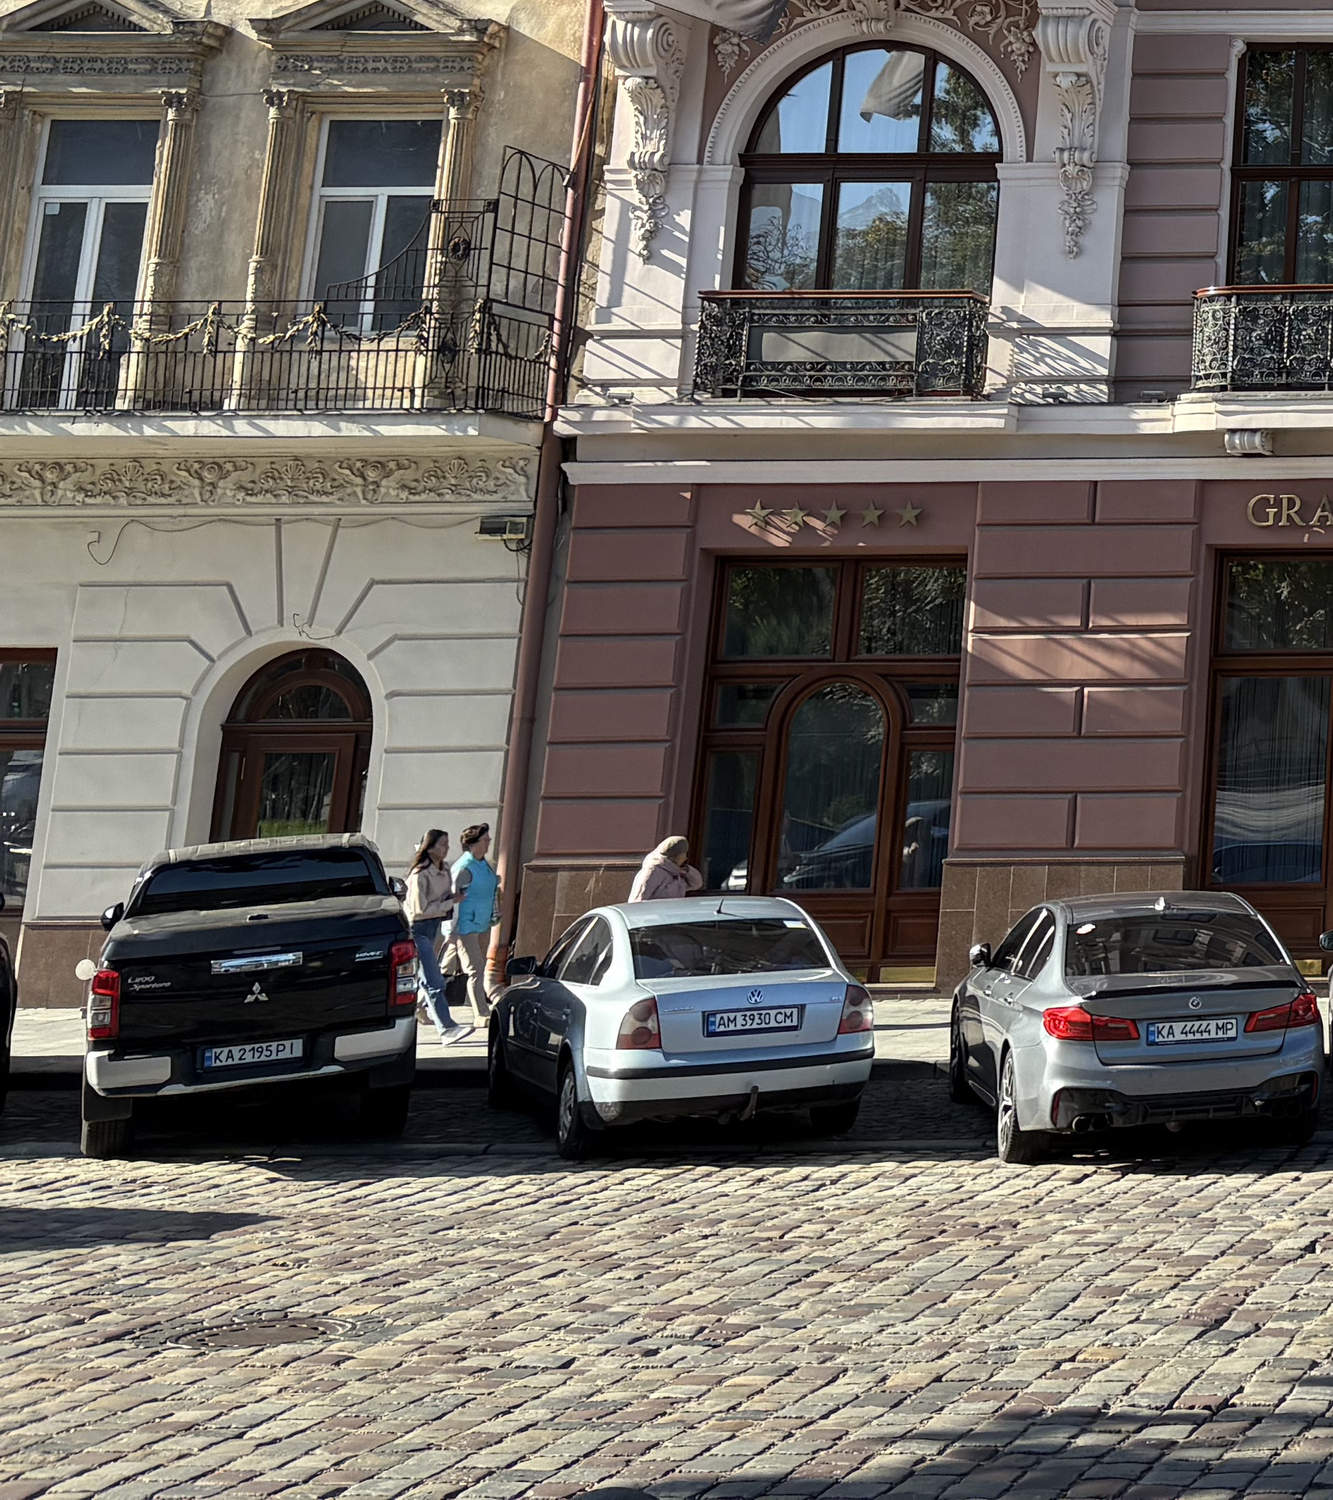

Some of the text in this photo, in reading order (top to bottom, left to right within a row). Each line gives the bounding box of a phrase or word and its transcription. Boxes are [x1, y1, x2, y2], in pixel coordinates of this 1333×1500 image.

[717, 1011, 794, 1029] AM 3930 CM
[1156, 1021, 1234, 1039] KA 4444 MP
